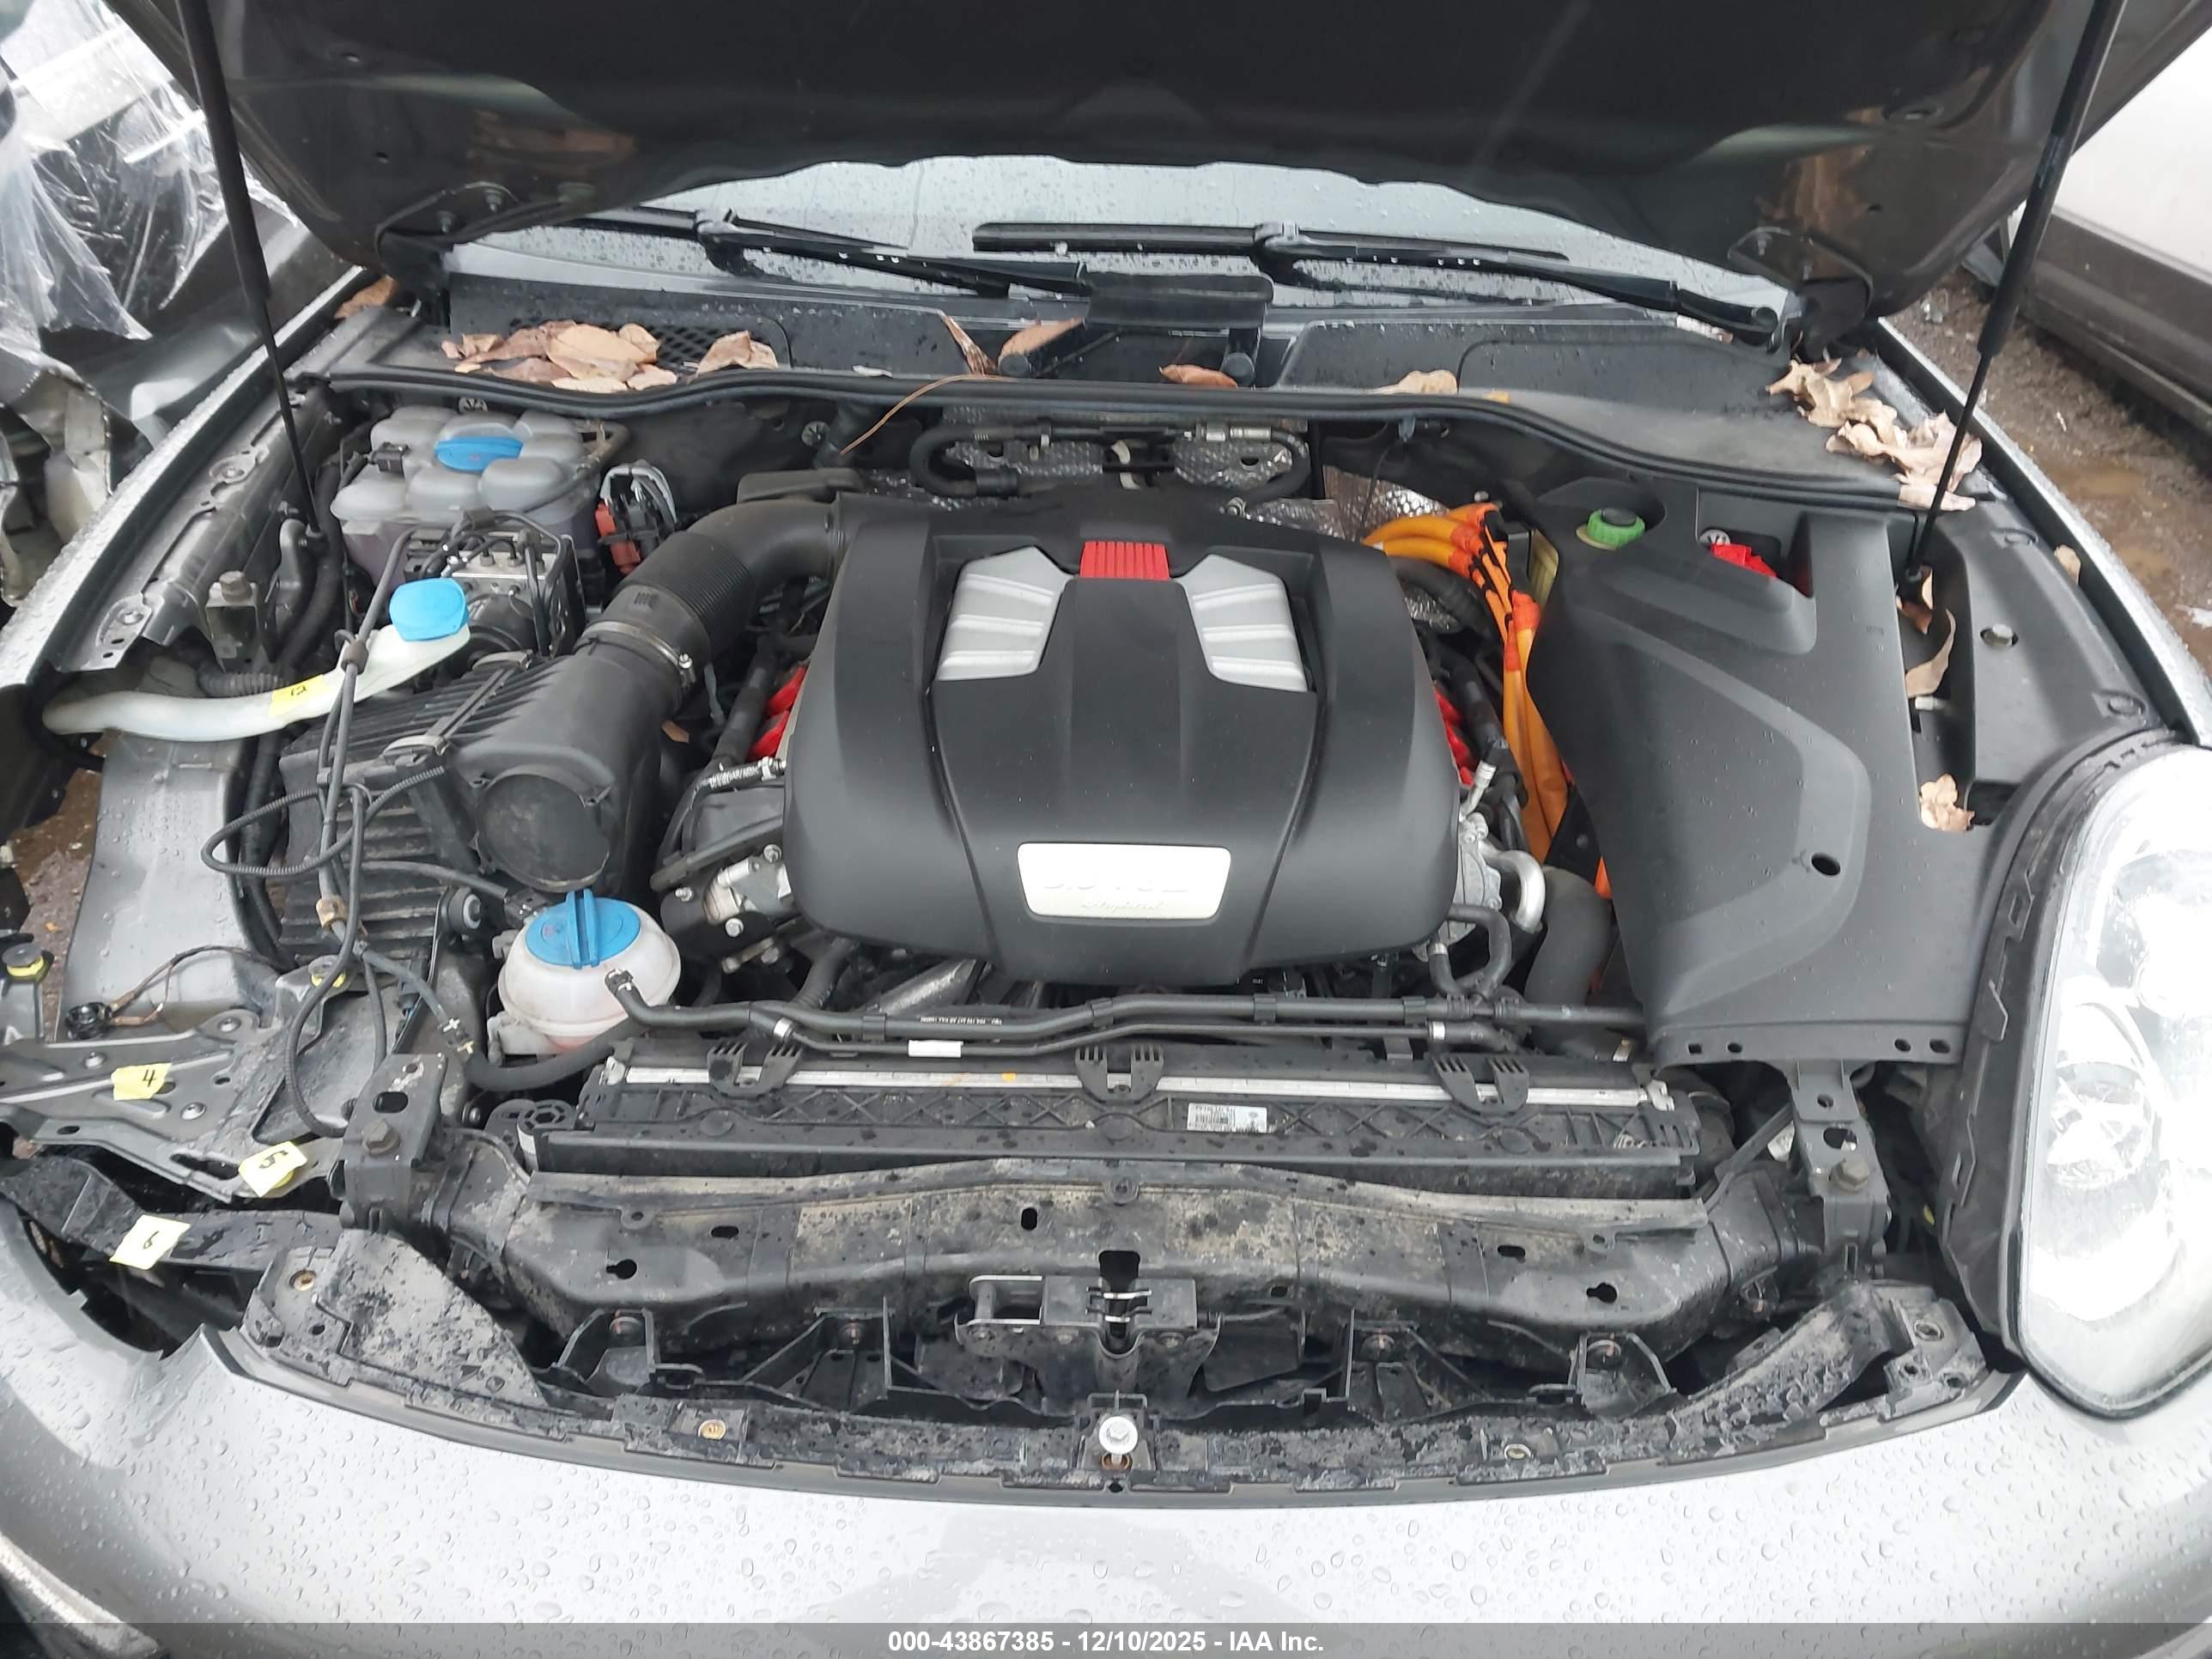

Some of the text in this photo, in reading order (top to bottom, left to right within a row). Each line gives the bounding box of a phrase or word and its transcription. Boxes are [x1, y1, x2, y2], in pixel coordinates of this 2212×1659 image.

[143, 1068, 157, 1088] 4
[258, 1149, 289, 1169] 5
[142, 1230, 160, 1250] 6
